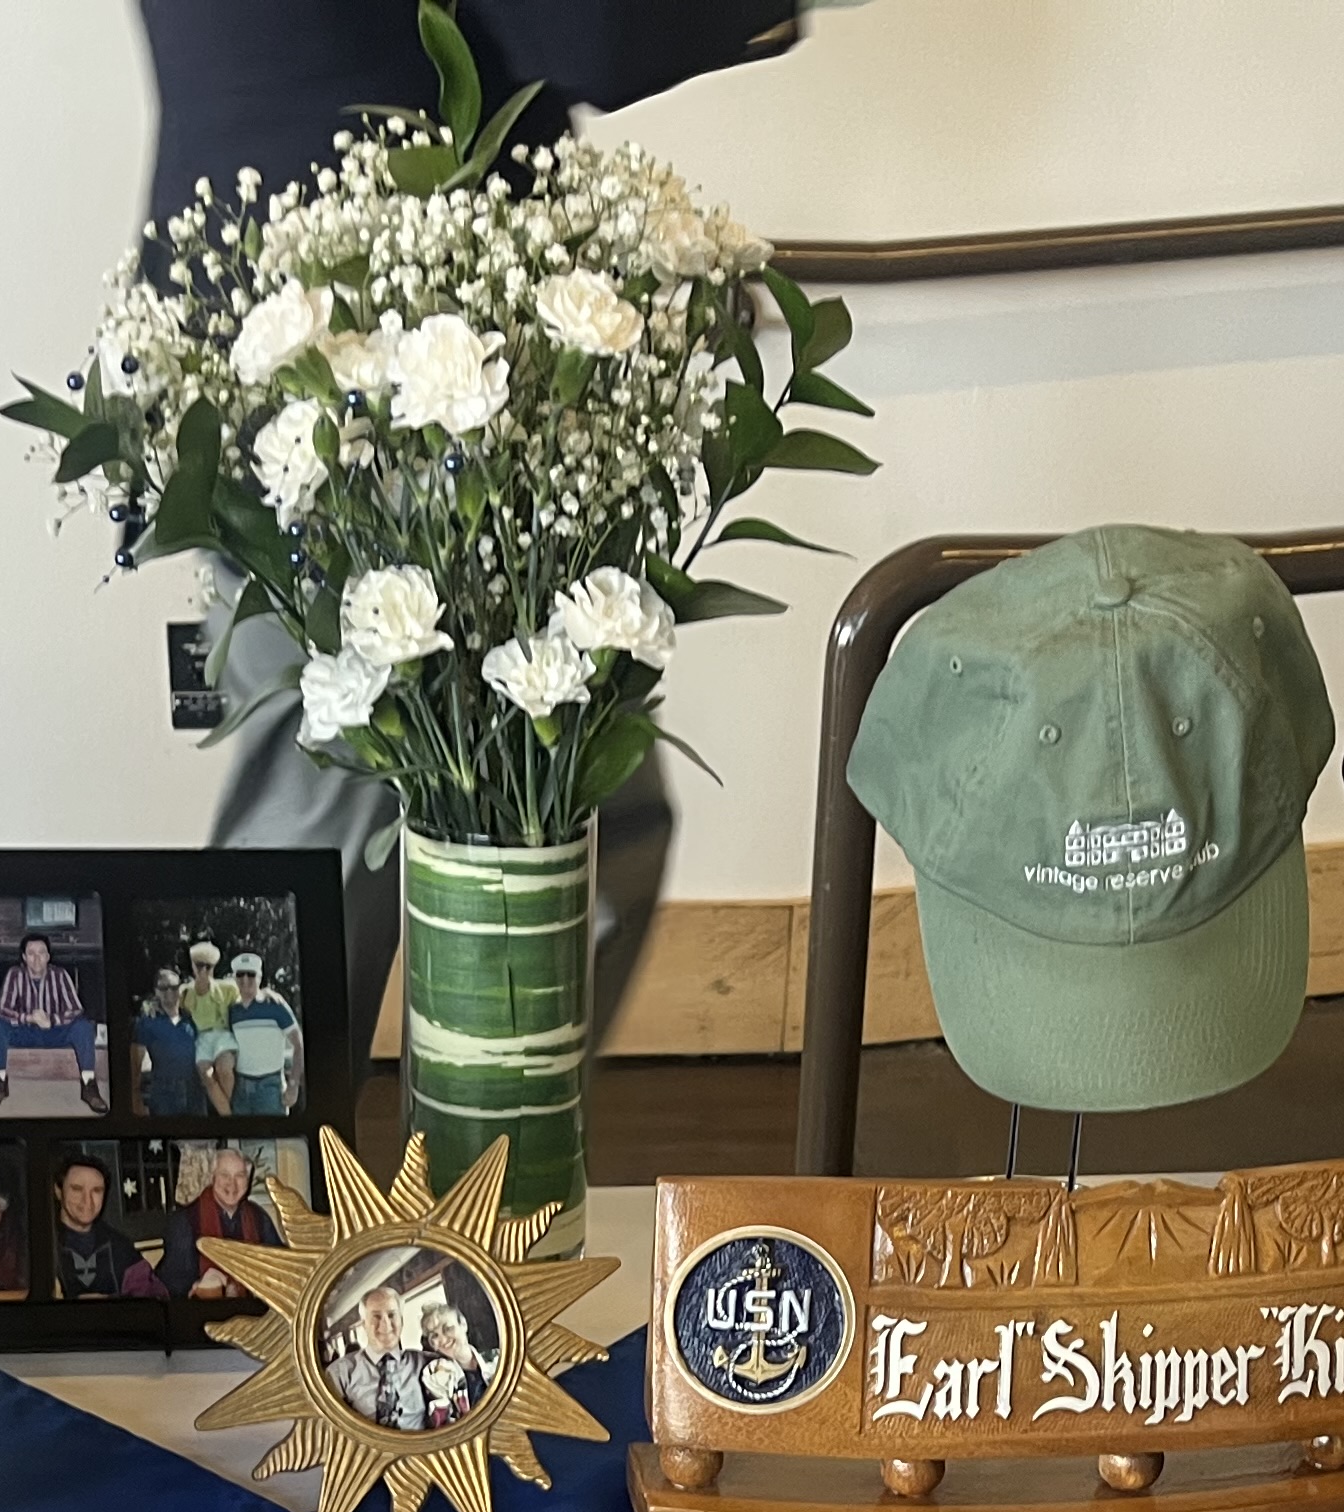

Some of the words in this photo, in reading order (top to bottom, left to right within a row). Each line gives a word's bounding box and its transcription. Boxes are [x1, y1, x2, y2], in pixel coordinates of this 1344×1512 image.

[1024, 863, 1098, 893] vintage
[1105, 864, 1183, 891] reserve
[1189, 839, 1219, 872] ub
[707, 1288, 812, 1333] USN
[869, 1313, 1014, 1421] Earl
